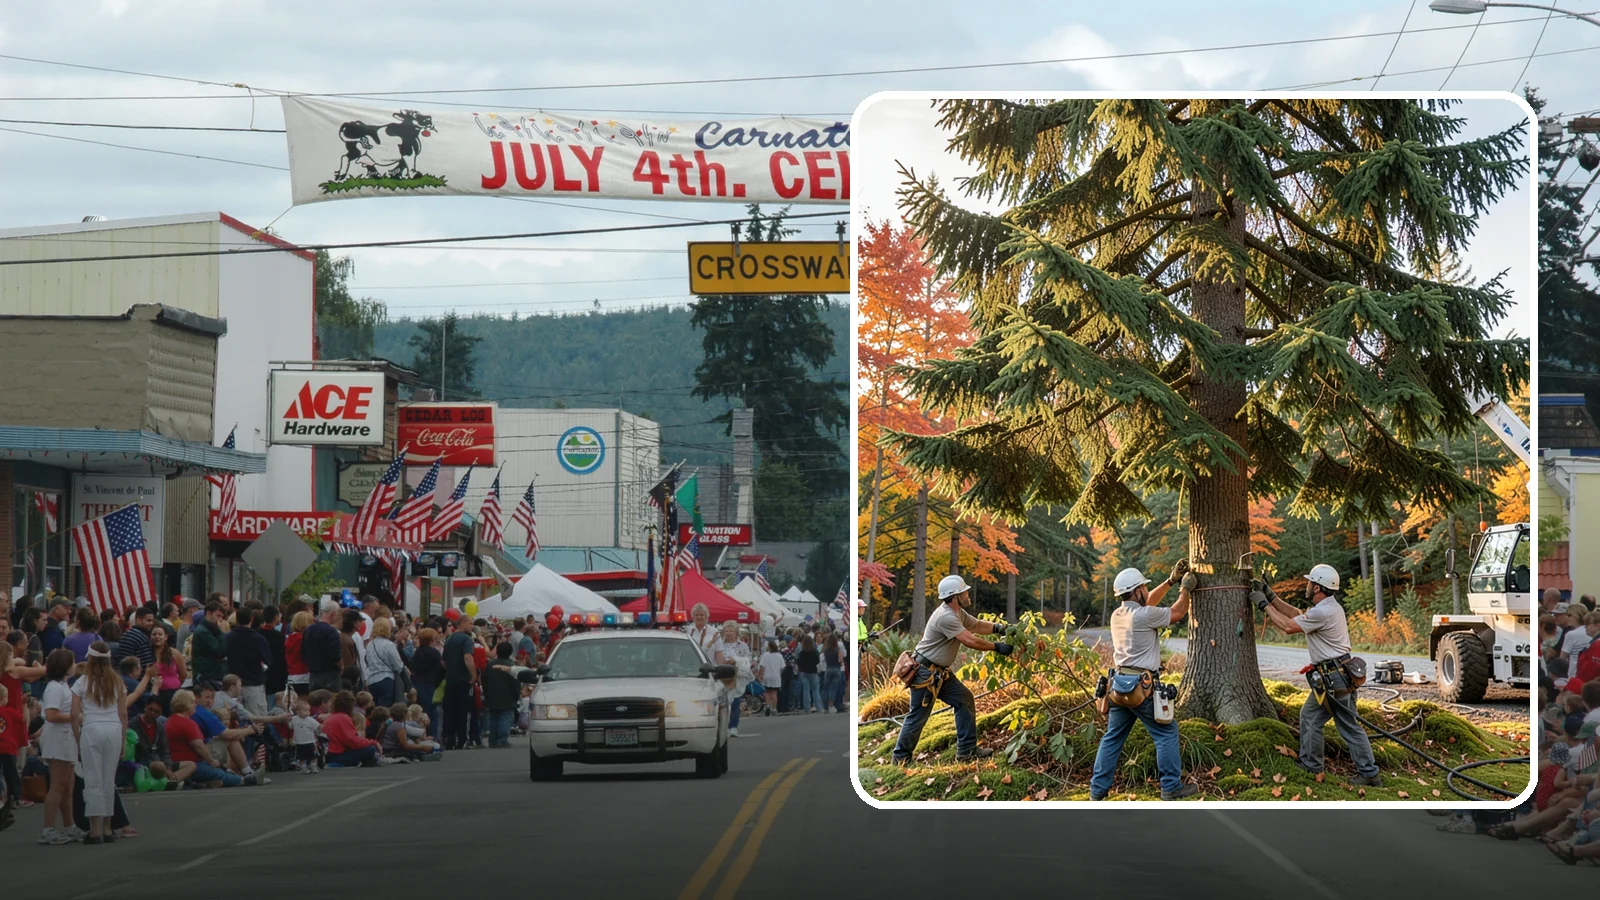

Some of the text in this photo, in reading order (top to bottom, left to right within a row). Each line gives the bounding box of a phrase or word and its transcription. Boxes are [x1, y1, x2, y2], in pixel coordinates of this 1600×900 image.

[481, 141, 605, 192] JULY
[633, 150, 746, 198] 4th.
[697, 254, 850, 280] CROSSWA
[283, 380, 373, 420] ACE
[405, 409, 453, 422] CEDAR
[284, 421, 370, 436] Hardware
[416, 428, 477, 447] Coca-Cola
[353, 467, 387, 480] Simpl
[96, 485, 124, 494] Vincent
[126, 486, 136, 495] de
[138, 486, 155, 495] Paul
[688, 526, 741, 535] CRNATION
[699, 535, 730, 544] GLASS
